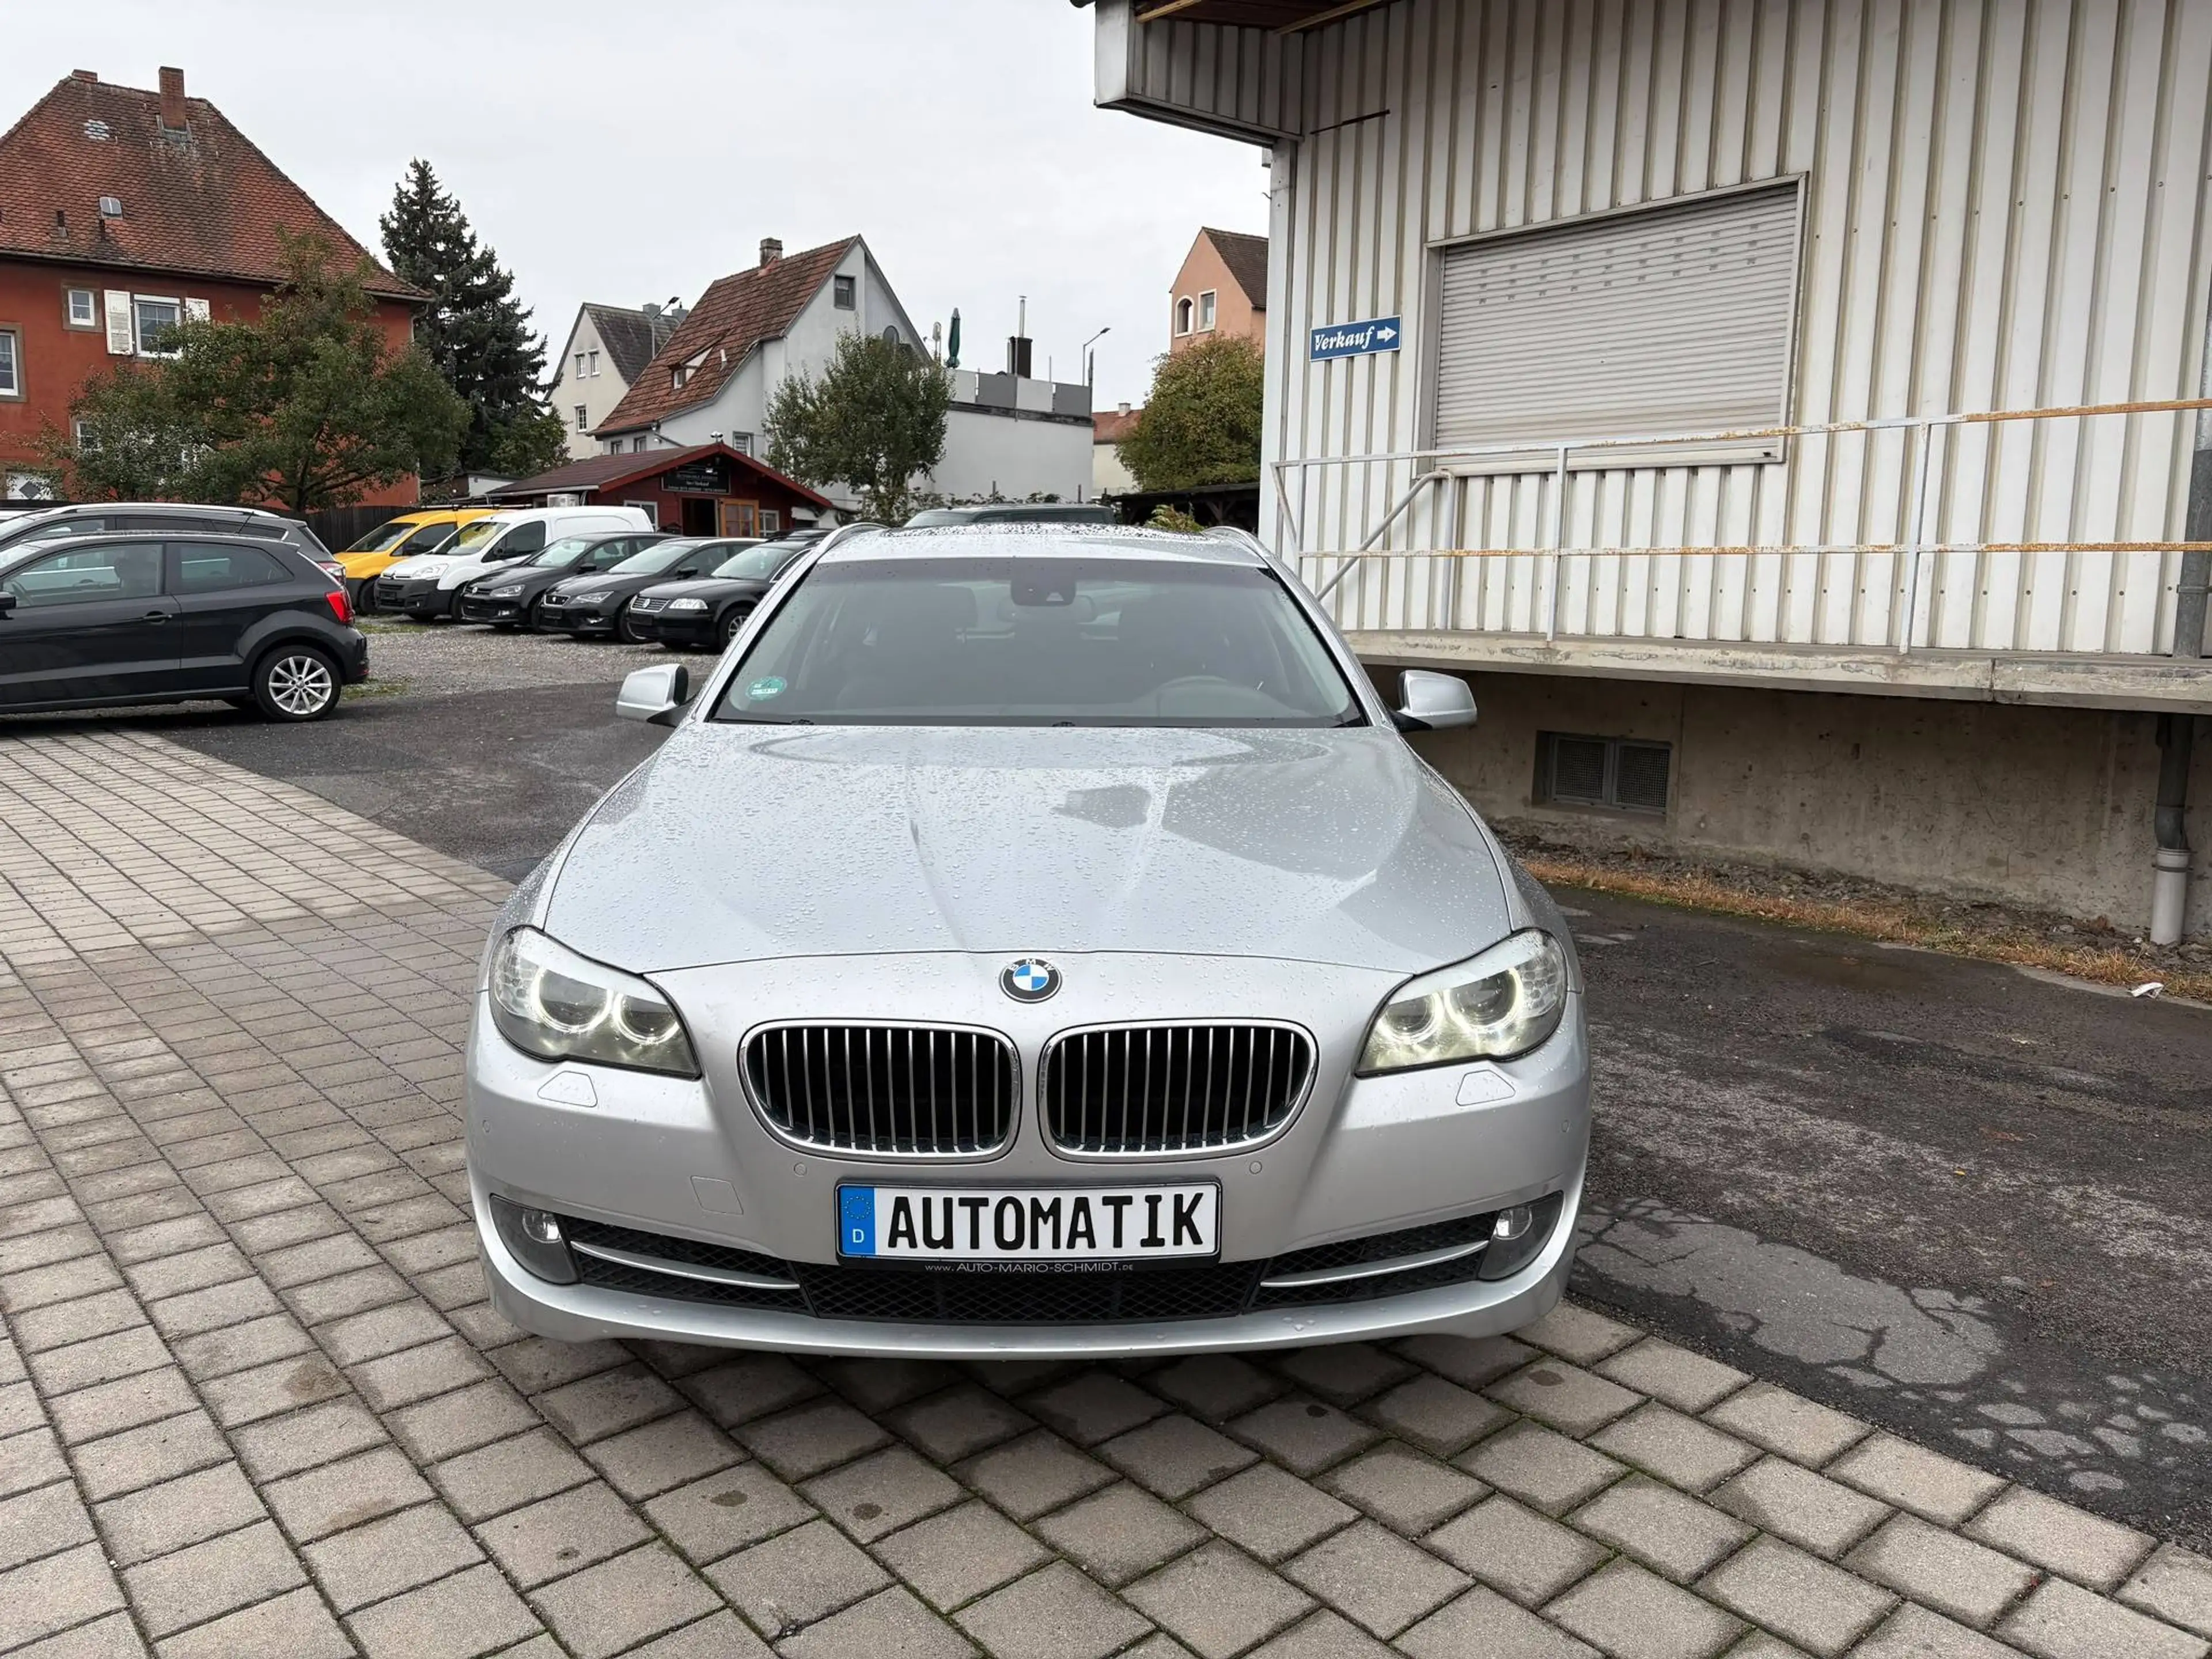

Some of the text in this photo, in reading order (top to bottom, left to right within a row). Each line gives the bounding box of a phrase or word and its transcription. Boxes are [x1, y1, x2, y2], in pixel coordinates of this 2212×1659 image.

[1314, 326, 1375, 351] Verkauf
[1007, 959, 1055, 971] BMW
[888, 1193, 1204, 1251] AUTOMATIK
[853, 1228, 865, 1243] D
